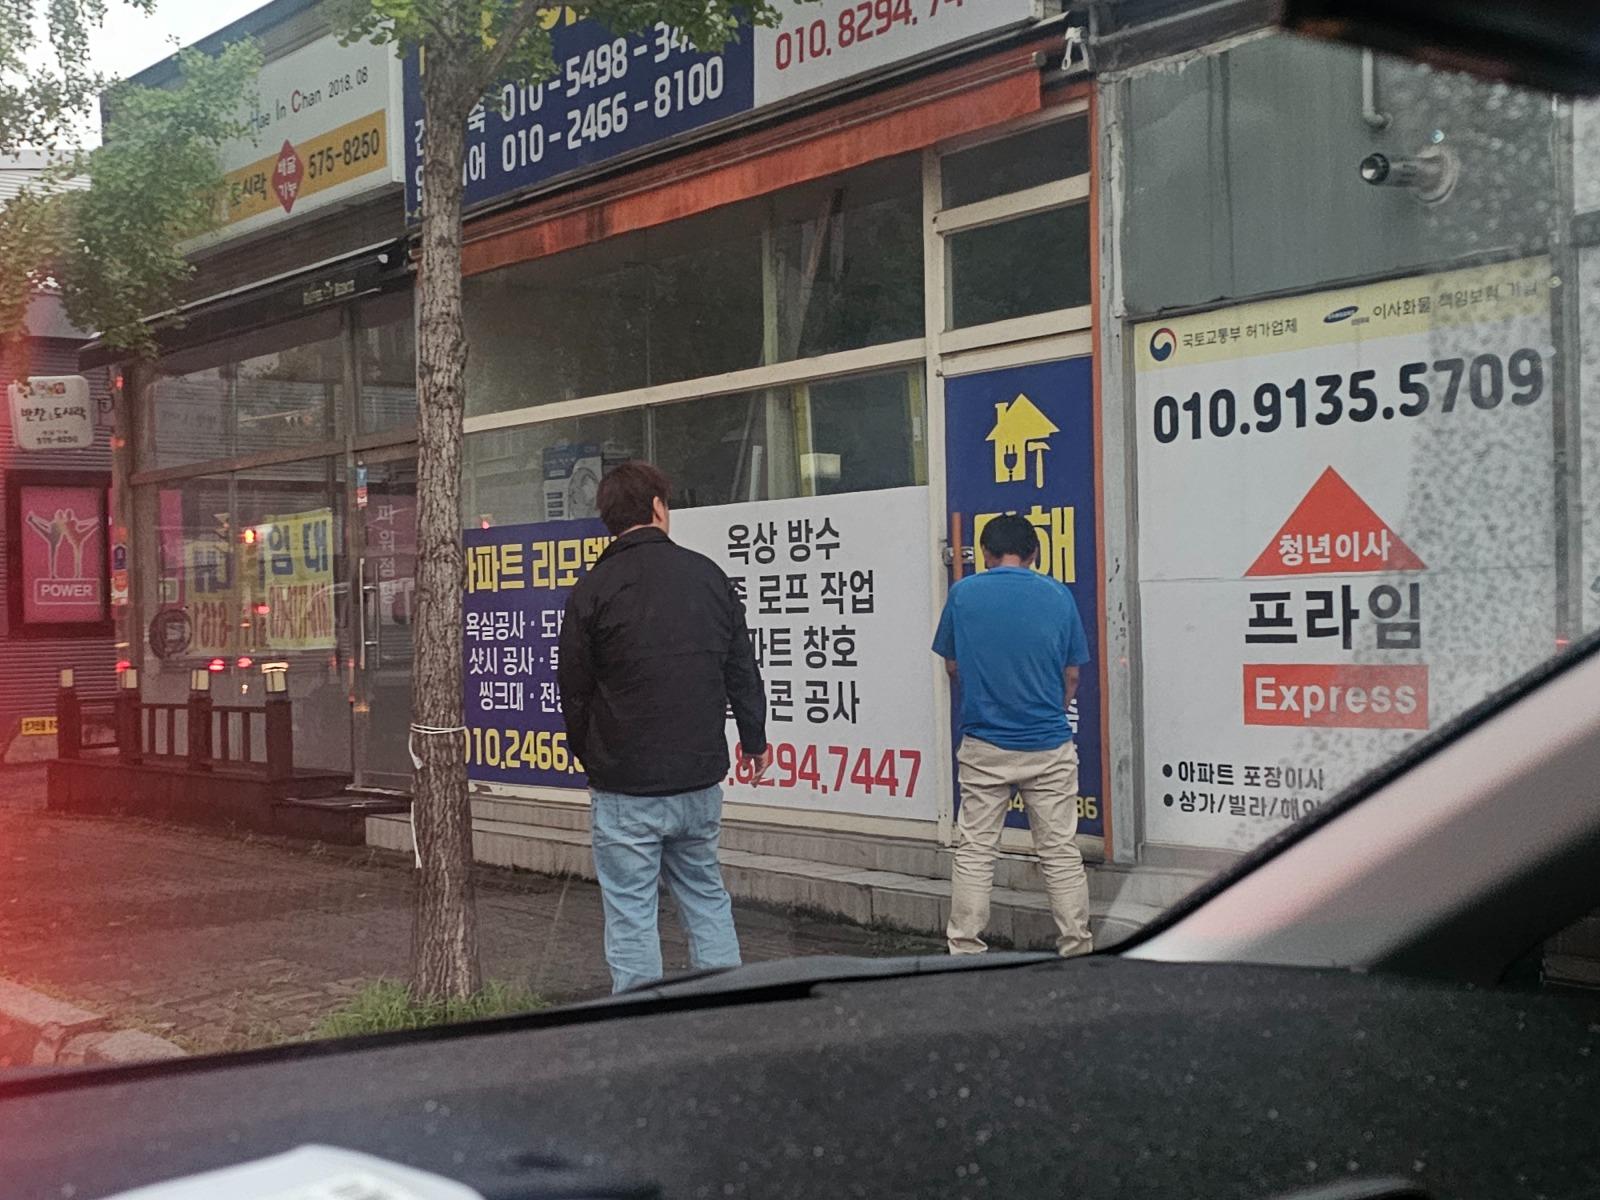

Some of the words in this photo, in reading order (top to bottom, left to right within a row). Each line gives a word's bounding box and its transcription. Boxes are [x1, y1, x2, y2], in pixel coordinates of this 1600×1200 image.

[501, 20, 697, 122] 010-5498-34
[291, 88, 322, 114] Chan
[502, 55, 724, 172] 010-2466-8100
[307, 127, 380, 180] 575-8250
[1246, 317, 1298, 338] 허가업체
[1153, 347, 1545, 444] 010.9135.5709
[268, 519, 329, 576] 임대
[532, 536, 617, 590] 리모
[727, 521, 778, 565] 옥상
[788, 517, 841, 563] 방수
[974, 505, 1076, 583] 해
[1278, 528, 1392, 566] 청년이사
[41, 584, 93, 597] POWER
[758, 573, 810, 614] 로프
[820, 569, 874, 615] 작업
[465, 610, 526, 641] 욕실공사
[1245, 582, 1422, 650] 프라임
[502, 646, 535, 676] 공사
[748, 627, 793, 669] 파트
[803, 624, 858, 669] 창호
[479, 681, 524, 711] 씽크대
[540, 682, 563, 713] 전
[805, 680, 860, 724] 공사
[1254, 677, 1417, 718] Express
[728, 742, 921, 798] .8294.7447
[1178, 761, 1235, 786] 아파트
[1244, 765, 1325, 791] 포장이사
